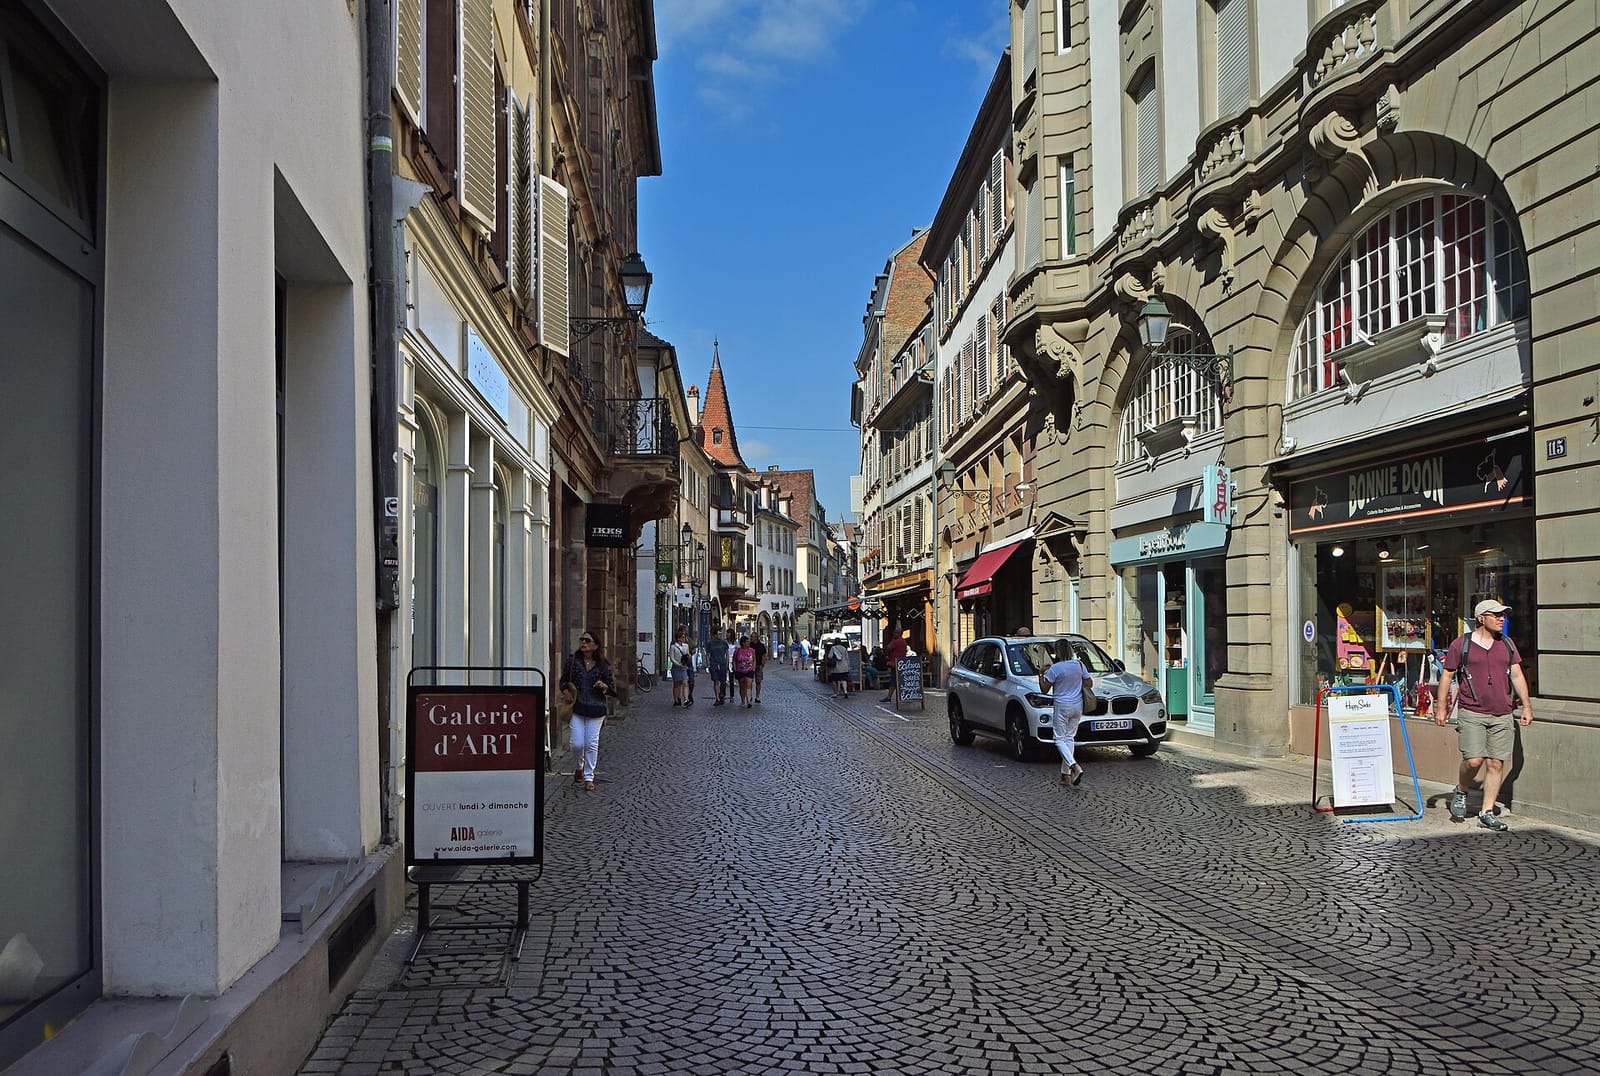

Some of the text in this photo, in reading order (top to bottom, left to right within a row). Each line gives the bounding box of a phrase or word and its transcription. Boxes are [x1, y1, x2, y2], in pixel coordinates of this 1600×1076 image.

[1548, 439, 1564, 456] 115
[1348, 456, 1444, 518] BONNIE DOON
[592, 527, 623, 535] IKKS
[1345, 699, 1371, 711] Happy Socks
[428, 704, 523, 726] Galerie
[434, 734, 518, 756] d'ART
[422, 803, 457, 811] OUVERT
[488, 802, 529, 810] dimanche
[450, 827, 503, 841] AIDA galerie
[434, 844, 518, 852] www.aida-galerie.com
